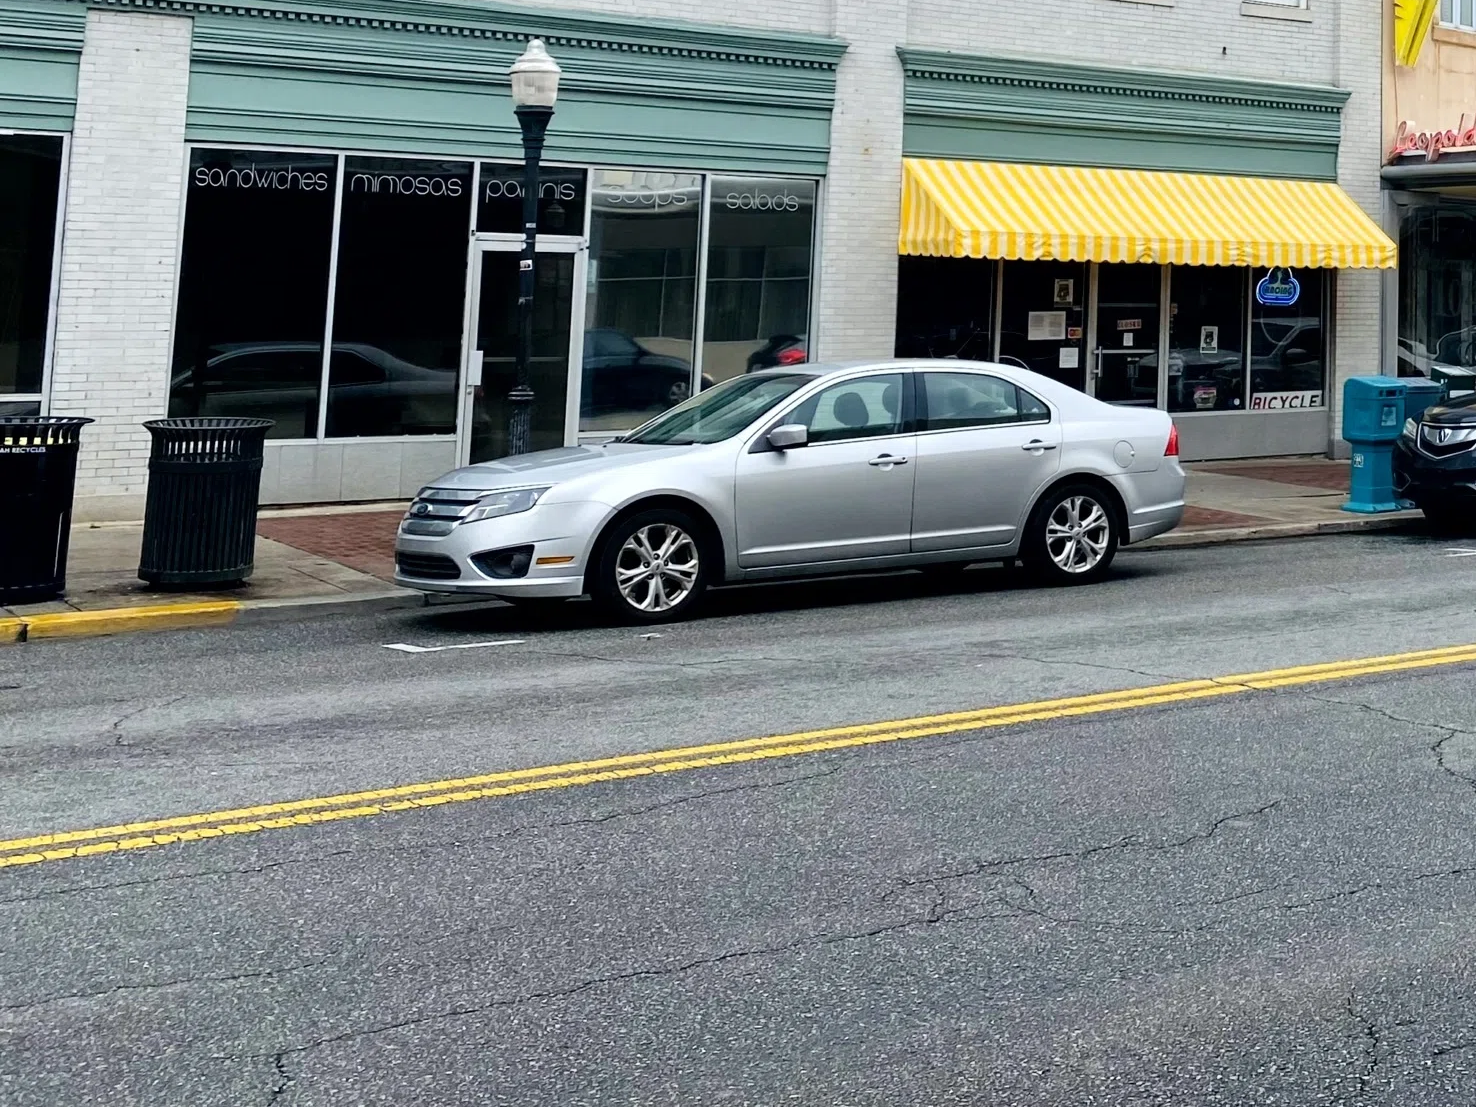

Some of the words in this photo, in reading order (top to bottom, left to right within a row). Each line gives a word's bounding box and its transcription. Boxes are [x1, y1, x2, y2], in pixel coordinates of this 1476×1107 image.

[195, 163, 328, 191] sandwiches
[351, 172, 462, 196] mimosas
[485, 180, 575, 203] painis
[726, 188, 799, 211] salads
[1253, 394, 1320, 409] BICYCLE
